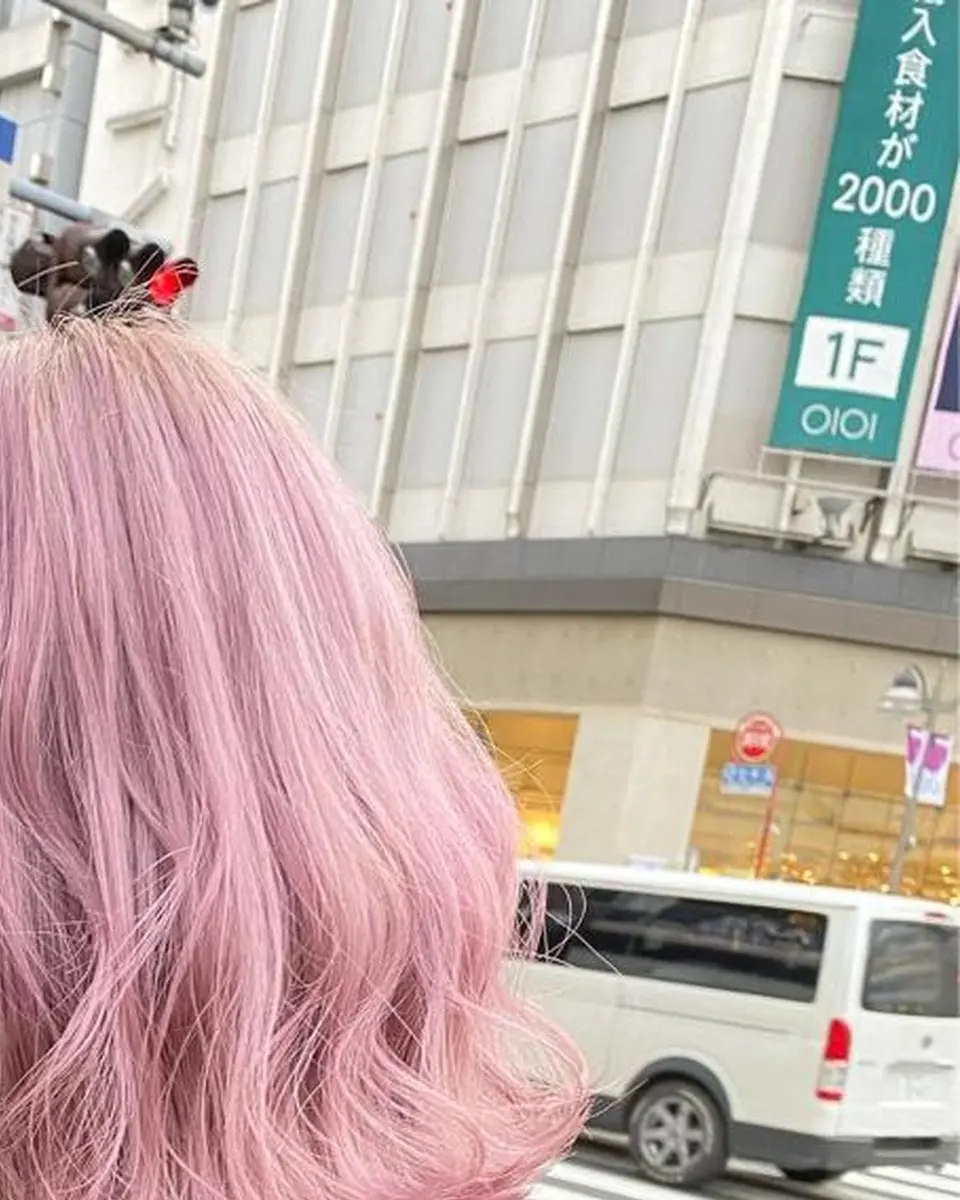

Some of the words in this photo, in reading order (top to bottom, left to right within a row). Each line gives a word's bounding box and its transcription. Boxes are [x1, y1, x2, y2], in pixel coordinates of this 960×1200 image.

[877, 0, 944, 168] 入食材が
[832, 172, 936, 223] 2000
[845, 226, 895, 308] 種類
[827, 331, 885, 381] 1F
